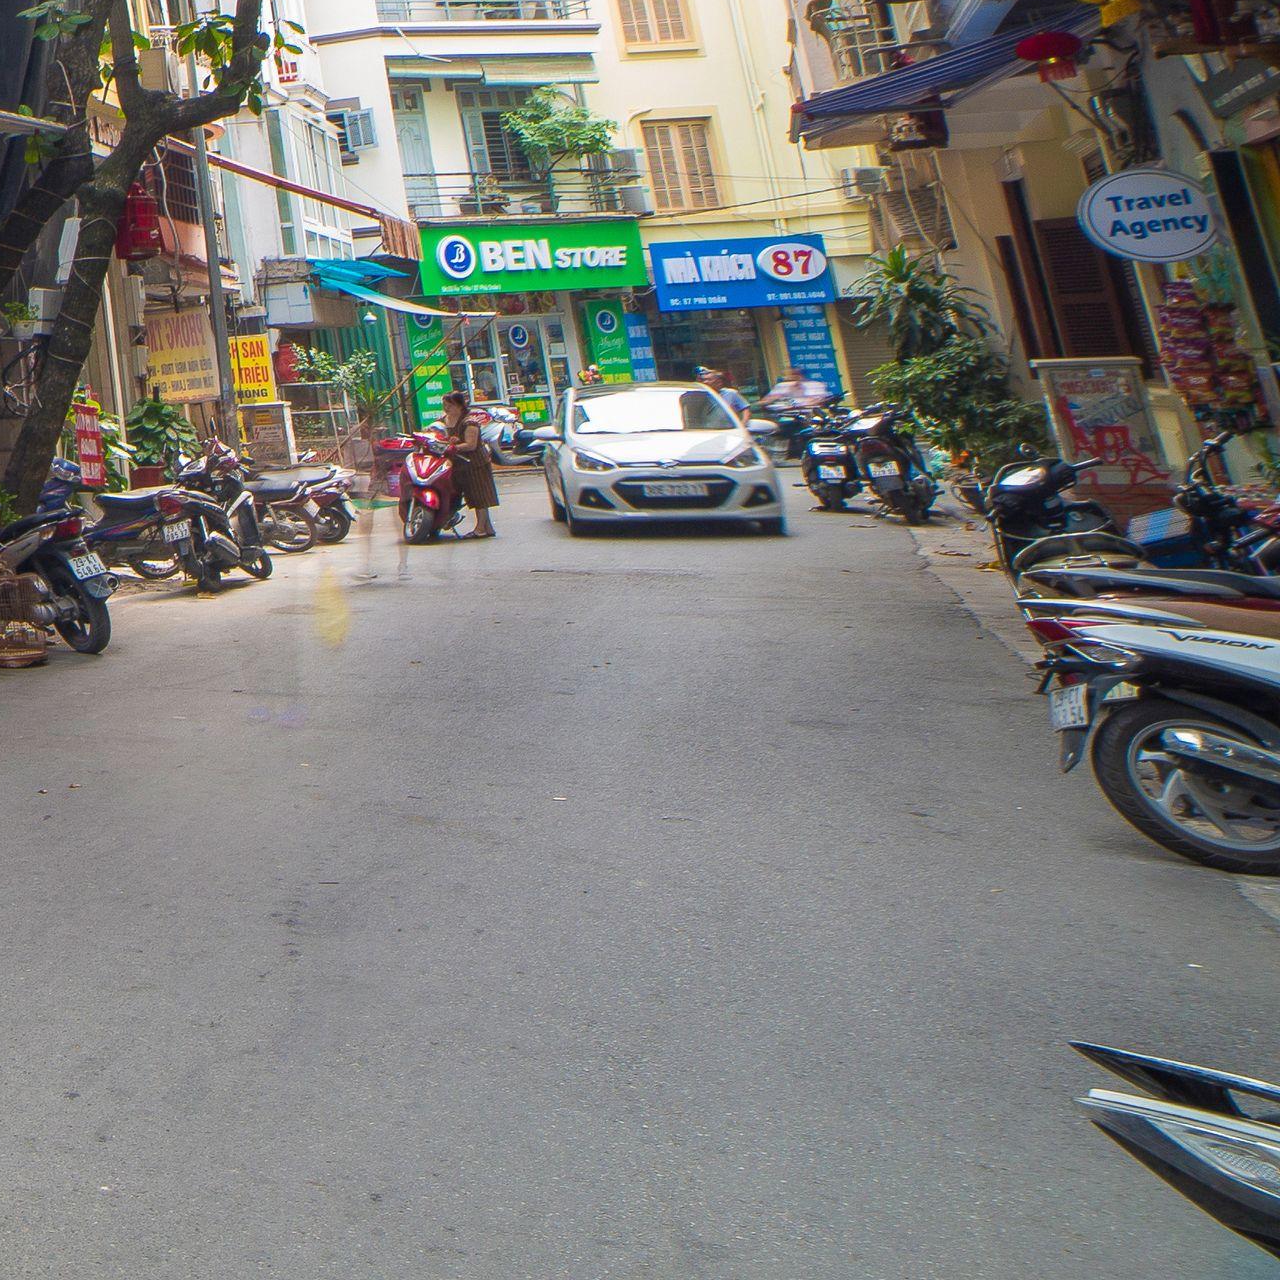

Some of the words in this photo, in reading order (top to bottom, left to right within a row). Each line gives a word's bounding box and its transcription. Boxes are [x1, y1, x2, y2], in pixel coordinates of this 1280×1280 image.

[1106, 188, 1192, 213] Travel
[1109, 214, 1209, 239] Agency
[479, 238, 553, 273] BEN
[555, 245, 628, 269] STORE
[662, 251, 701, 285] NHÀ
[699, 249, 757, 282] KHÁCH
[771, 250, 813, 277] 87
